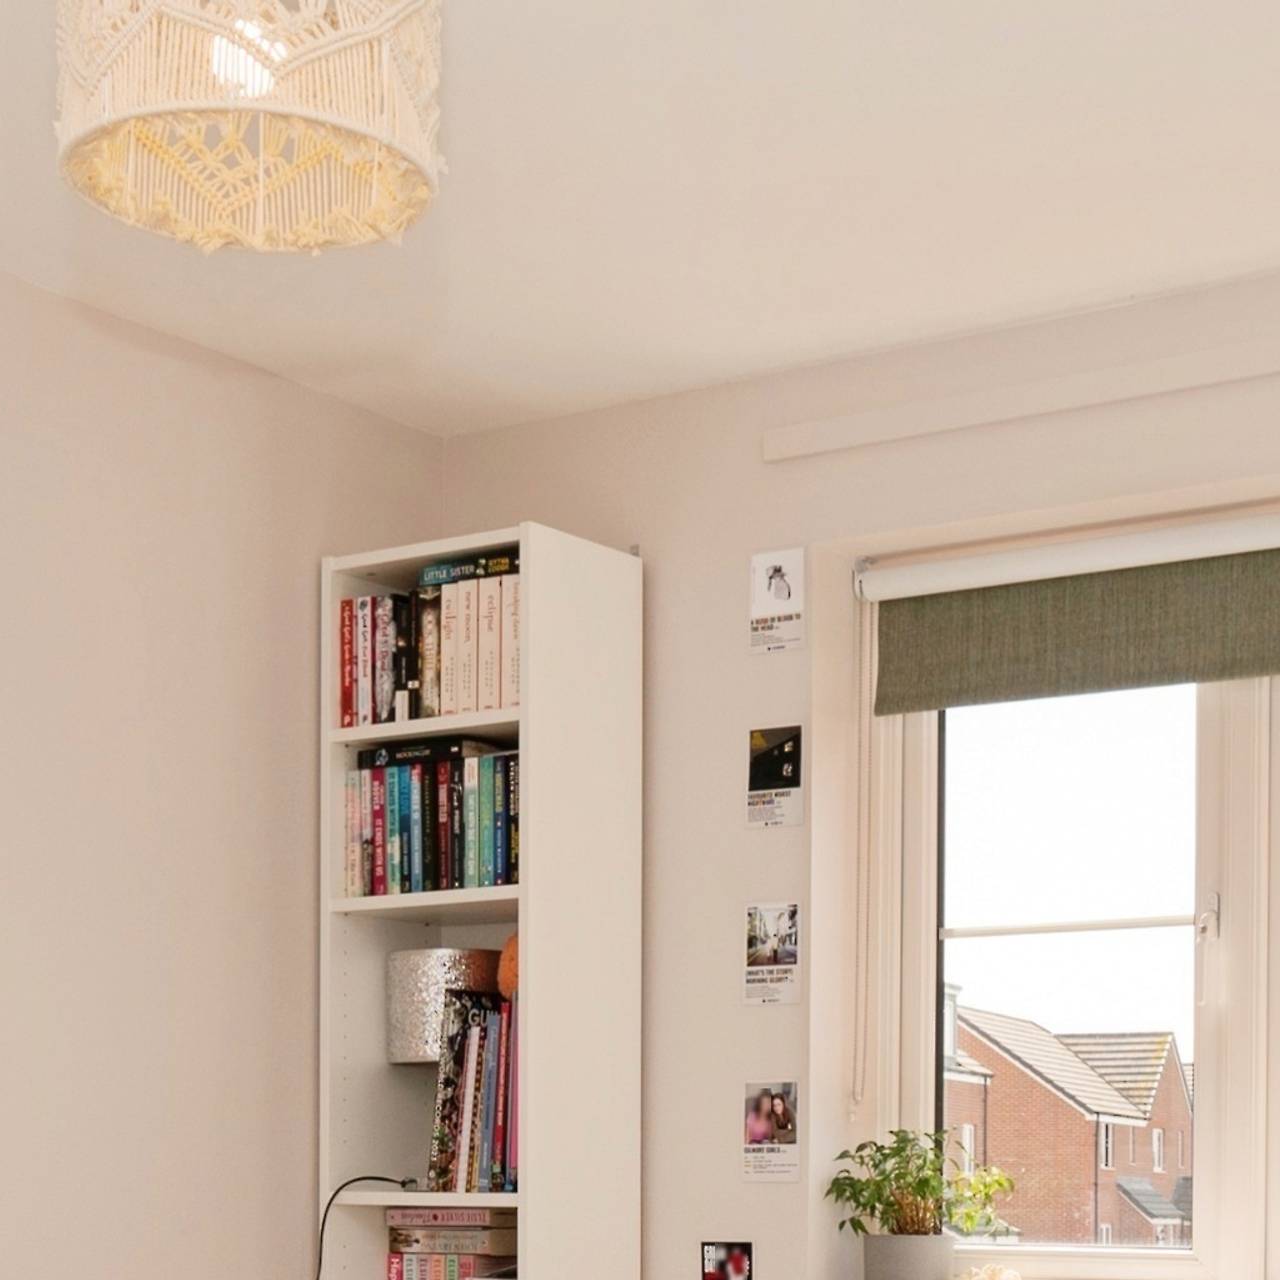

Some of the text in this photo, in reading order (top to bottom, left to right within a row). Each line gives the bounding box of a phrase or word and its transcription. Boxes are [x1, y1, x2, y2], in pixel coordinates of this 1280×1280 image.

[423, 564, 475, 581] LITTLE SISTER
[443, 599, 457, 640] twilight
[480, 595, 497, 632] eclipse
